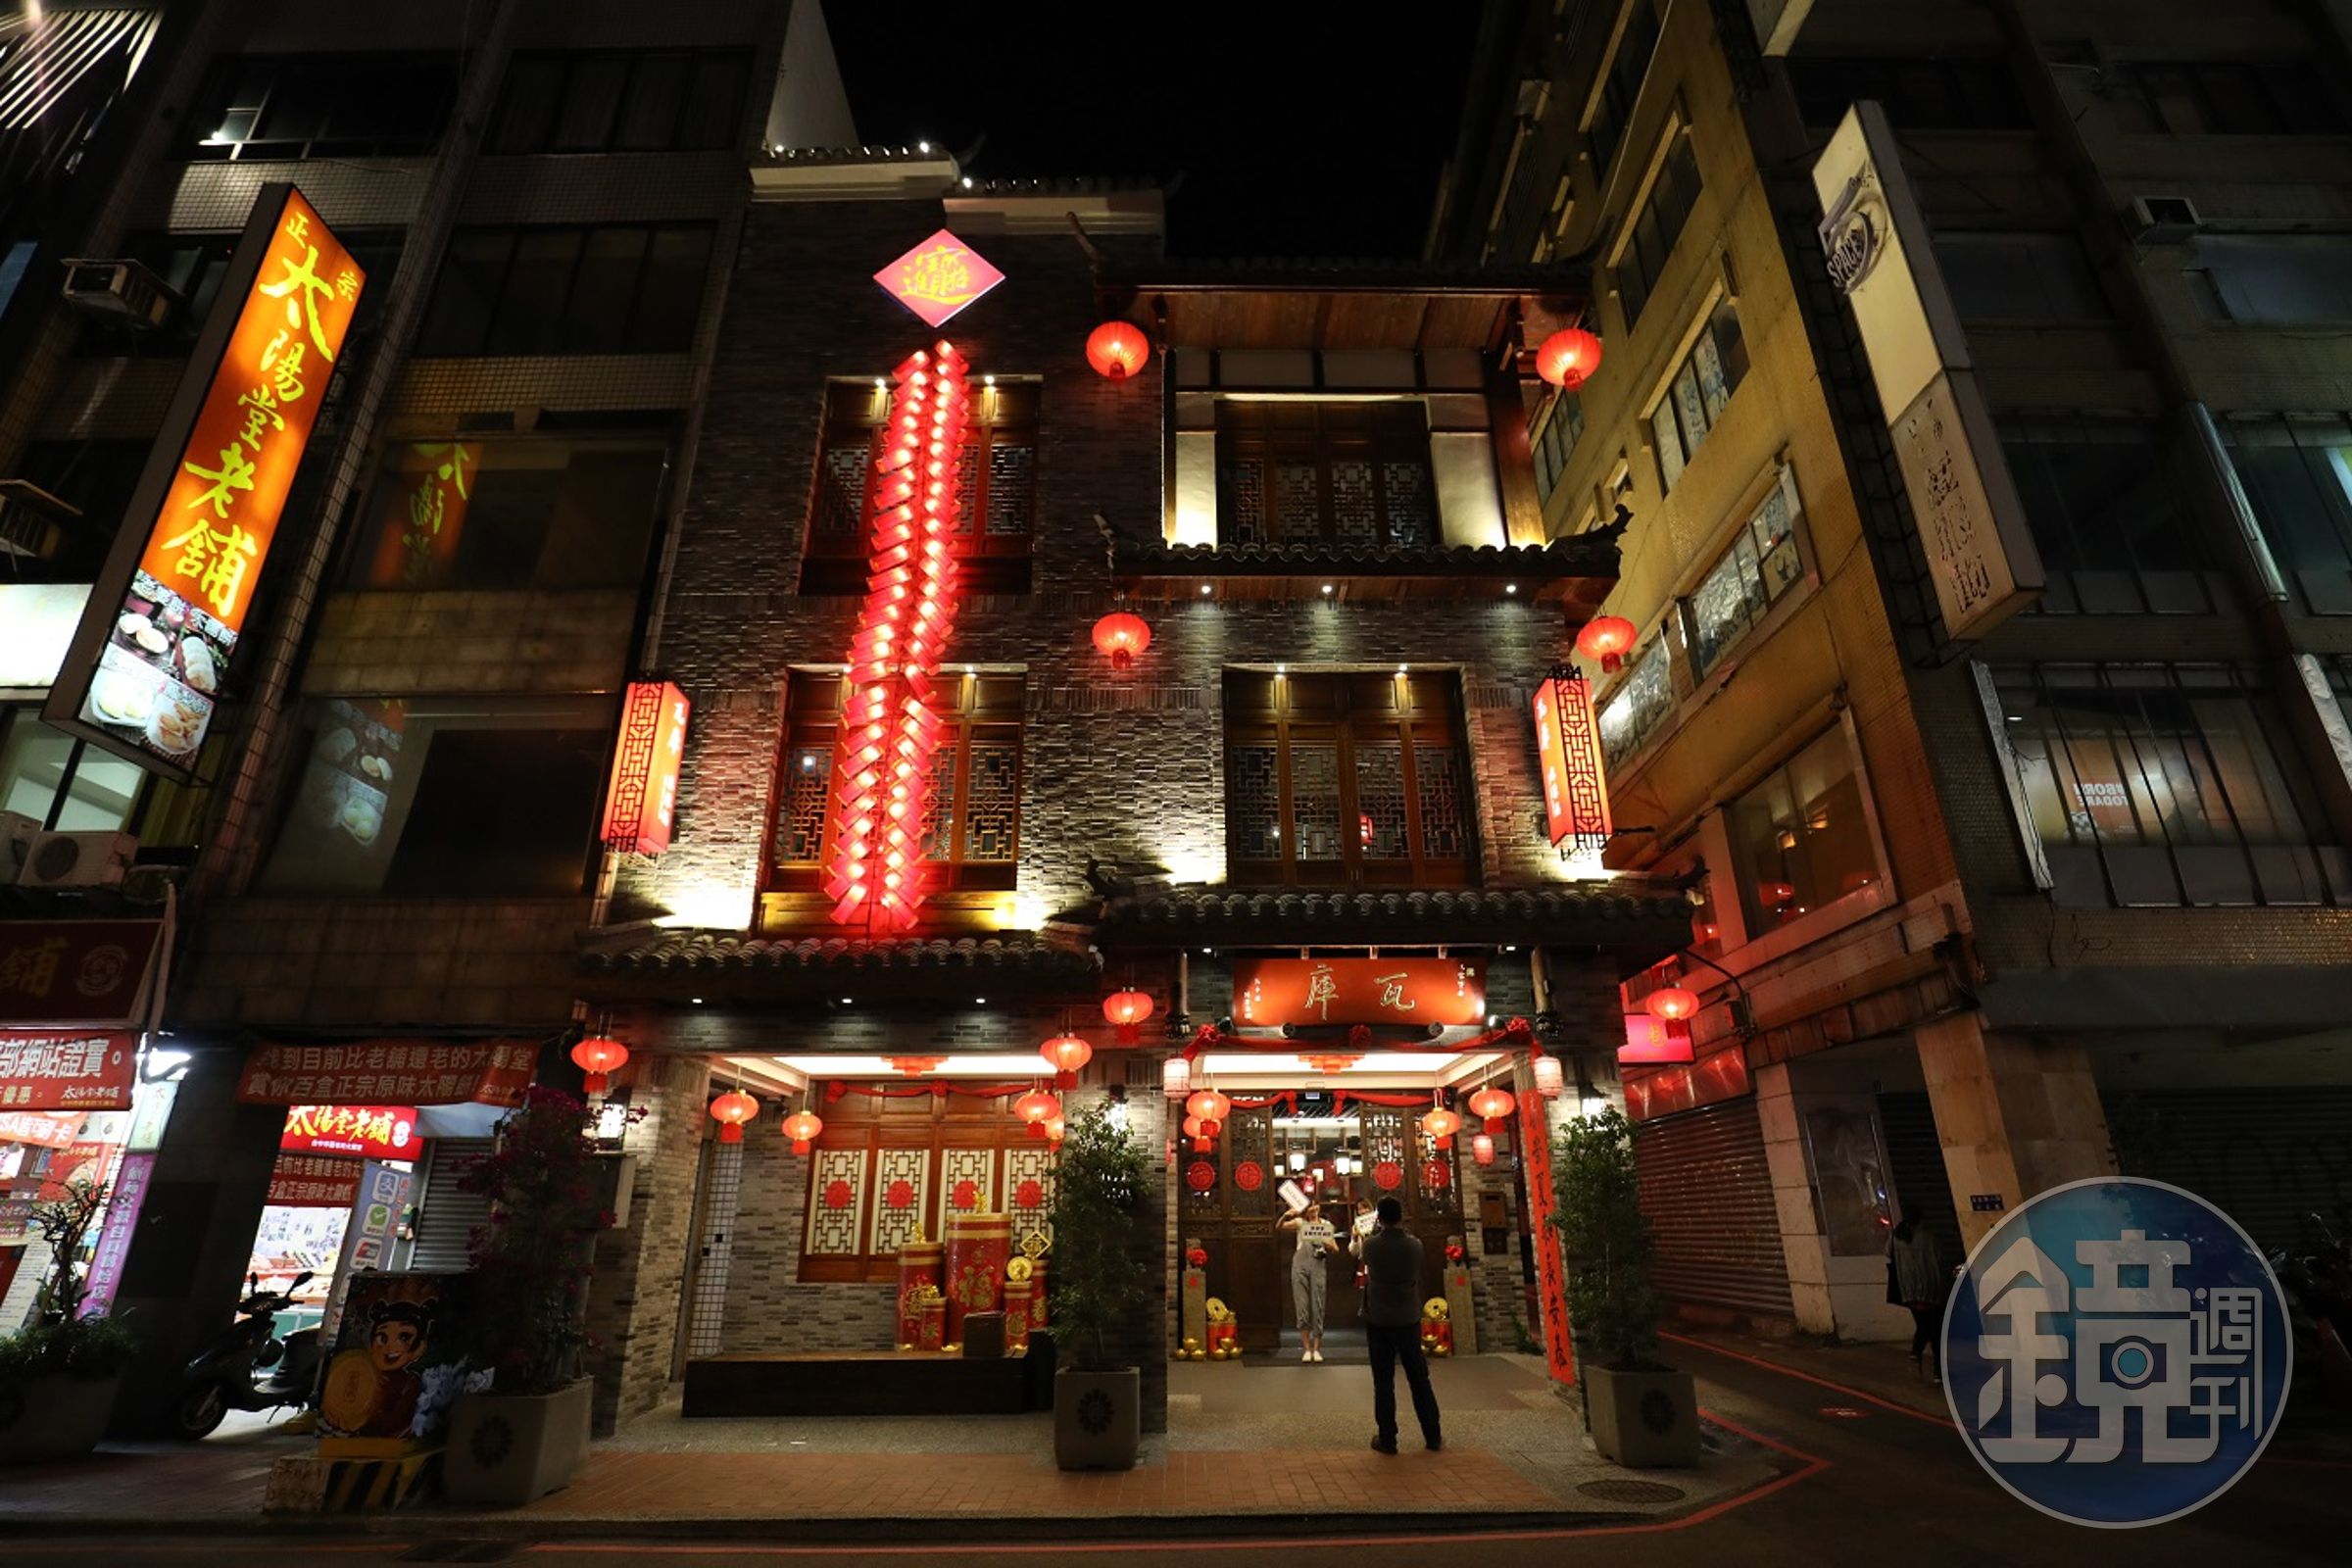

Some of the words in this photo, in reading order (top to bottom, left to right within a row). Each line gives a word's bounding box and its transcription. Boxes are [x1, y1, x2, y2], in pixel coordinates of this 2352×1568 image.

[161, 244, 334, 618] 太陽堂老舖
[0, 1038, 122, 1079] 部網站證實。
[283, 1104, 395, 1146] 太陽堂老舖
